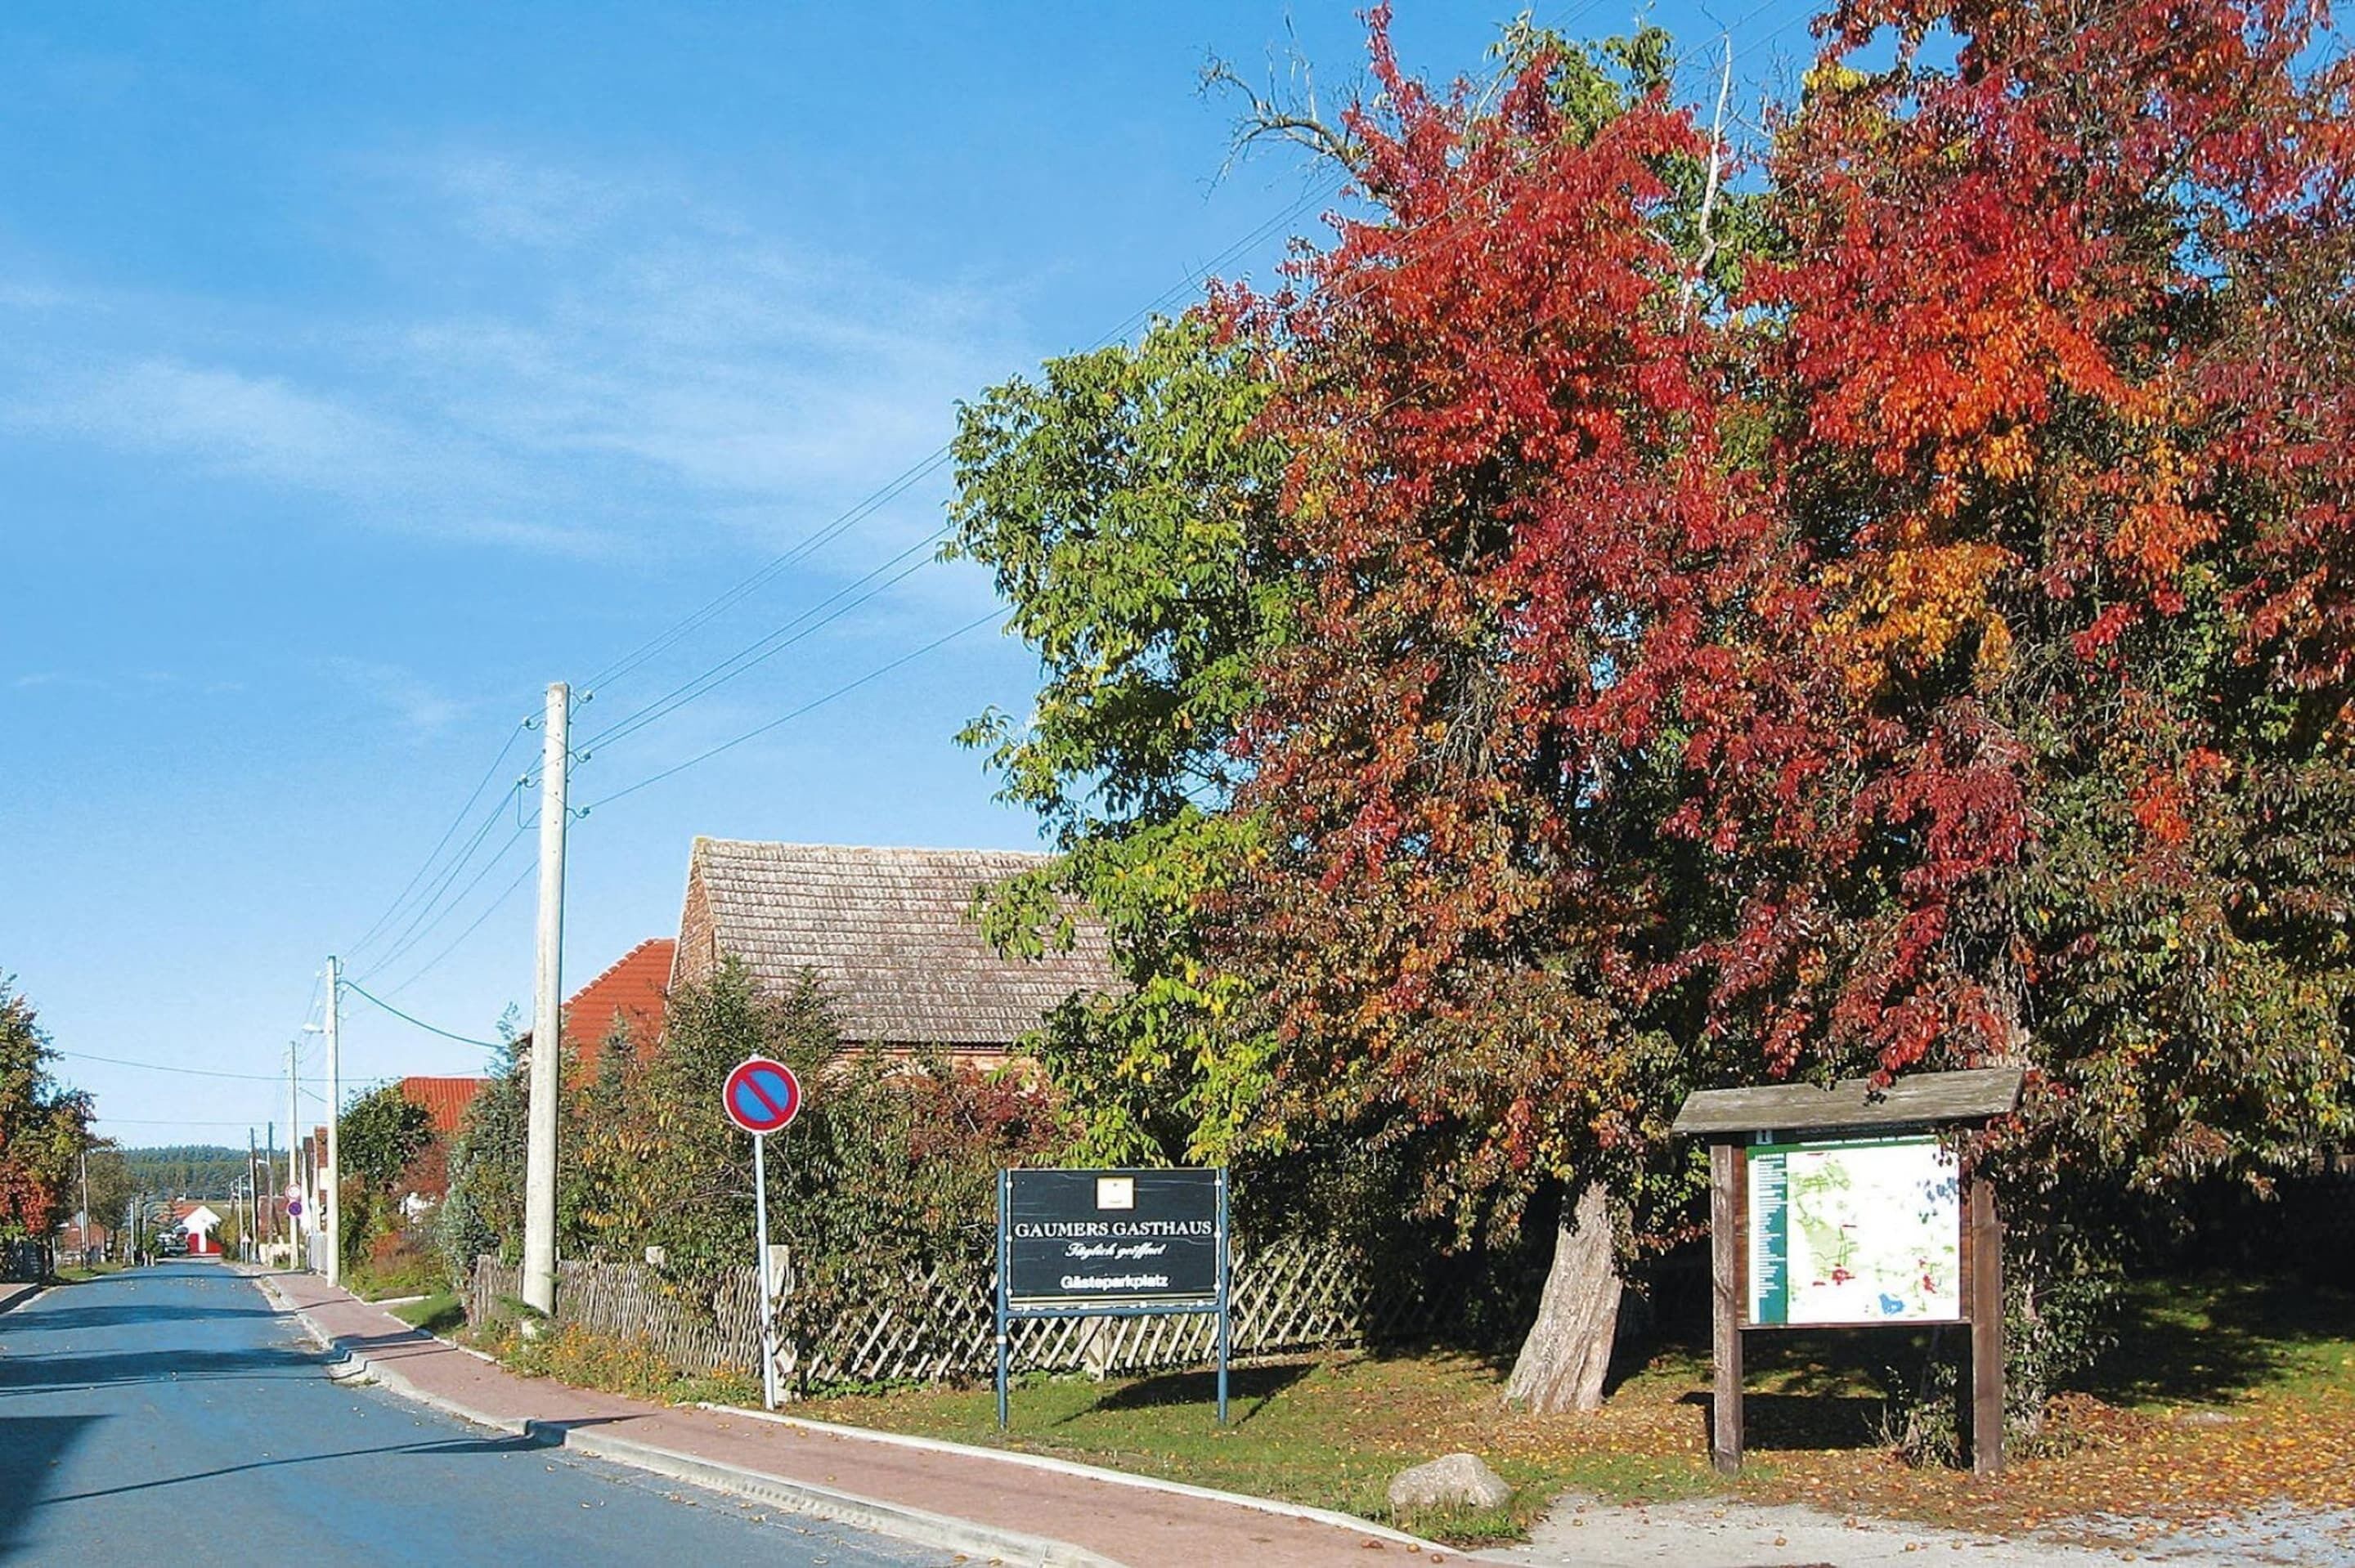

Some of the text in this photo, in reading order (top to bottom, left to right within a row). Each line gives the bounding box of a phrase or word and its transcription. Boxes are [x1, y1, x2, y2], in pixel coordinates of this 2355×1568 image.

[1015, 1221, 1212, 1238] GAUMERS GASTHAUS
[1065, 1242, 1166, 1260] Täglich geöffnet
[1061, 1274, 1169, 1290] Gästeparkplatz
